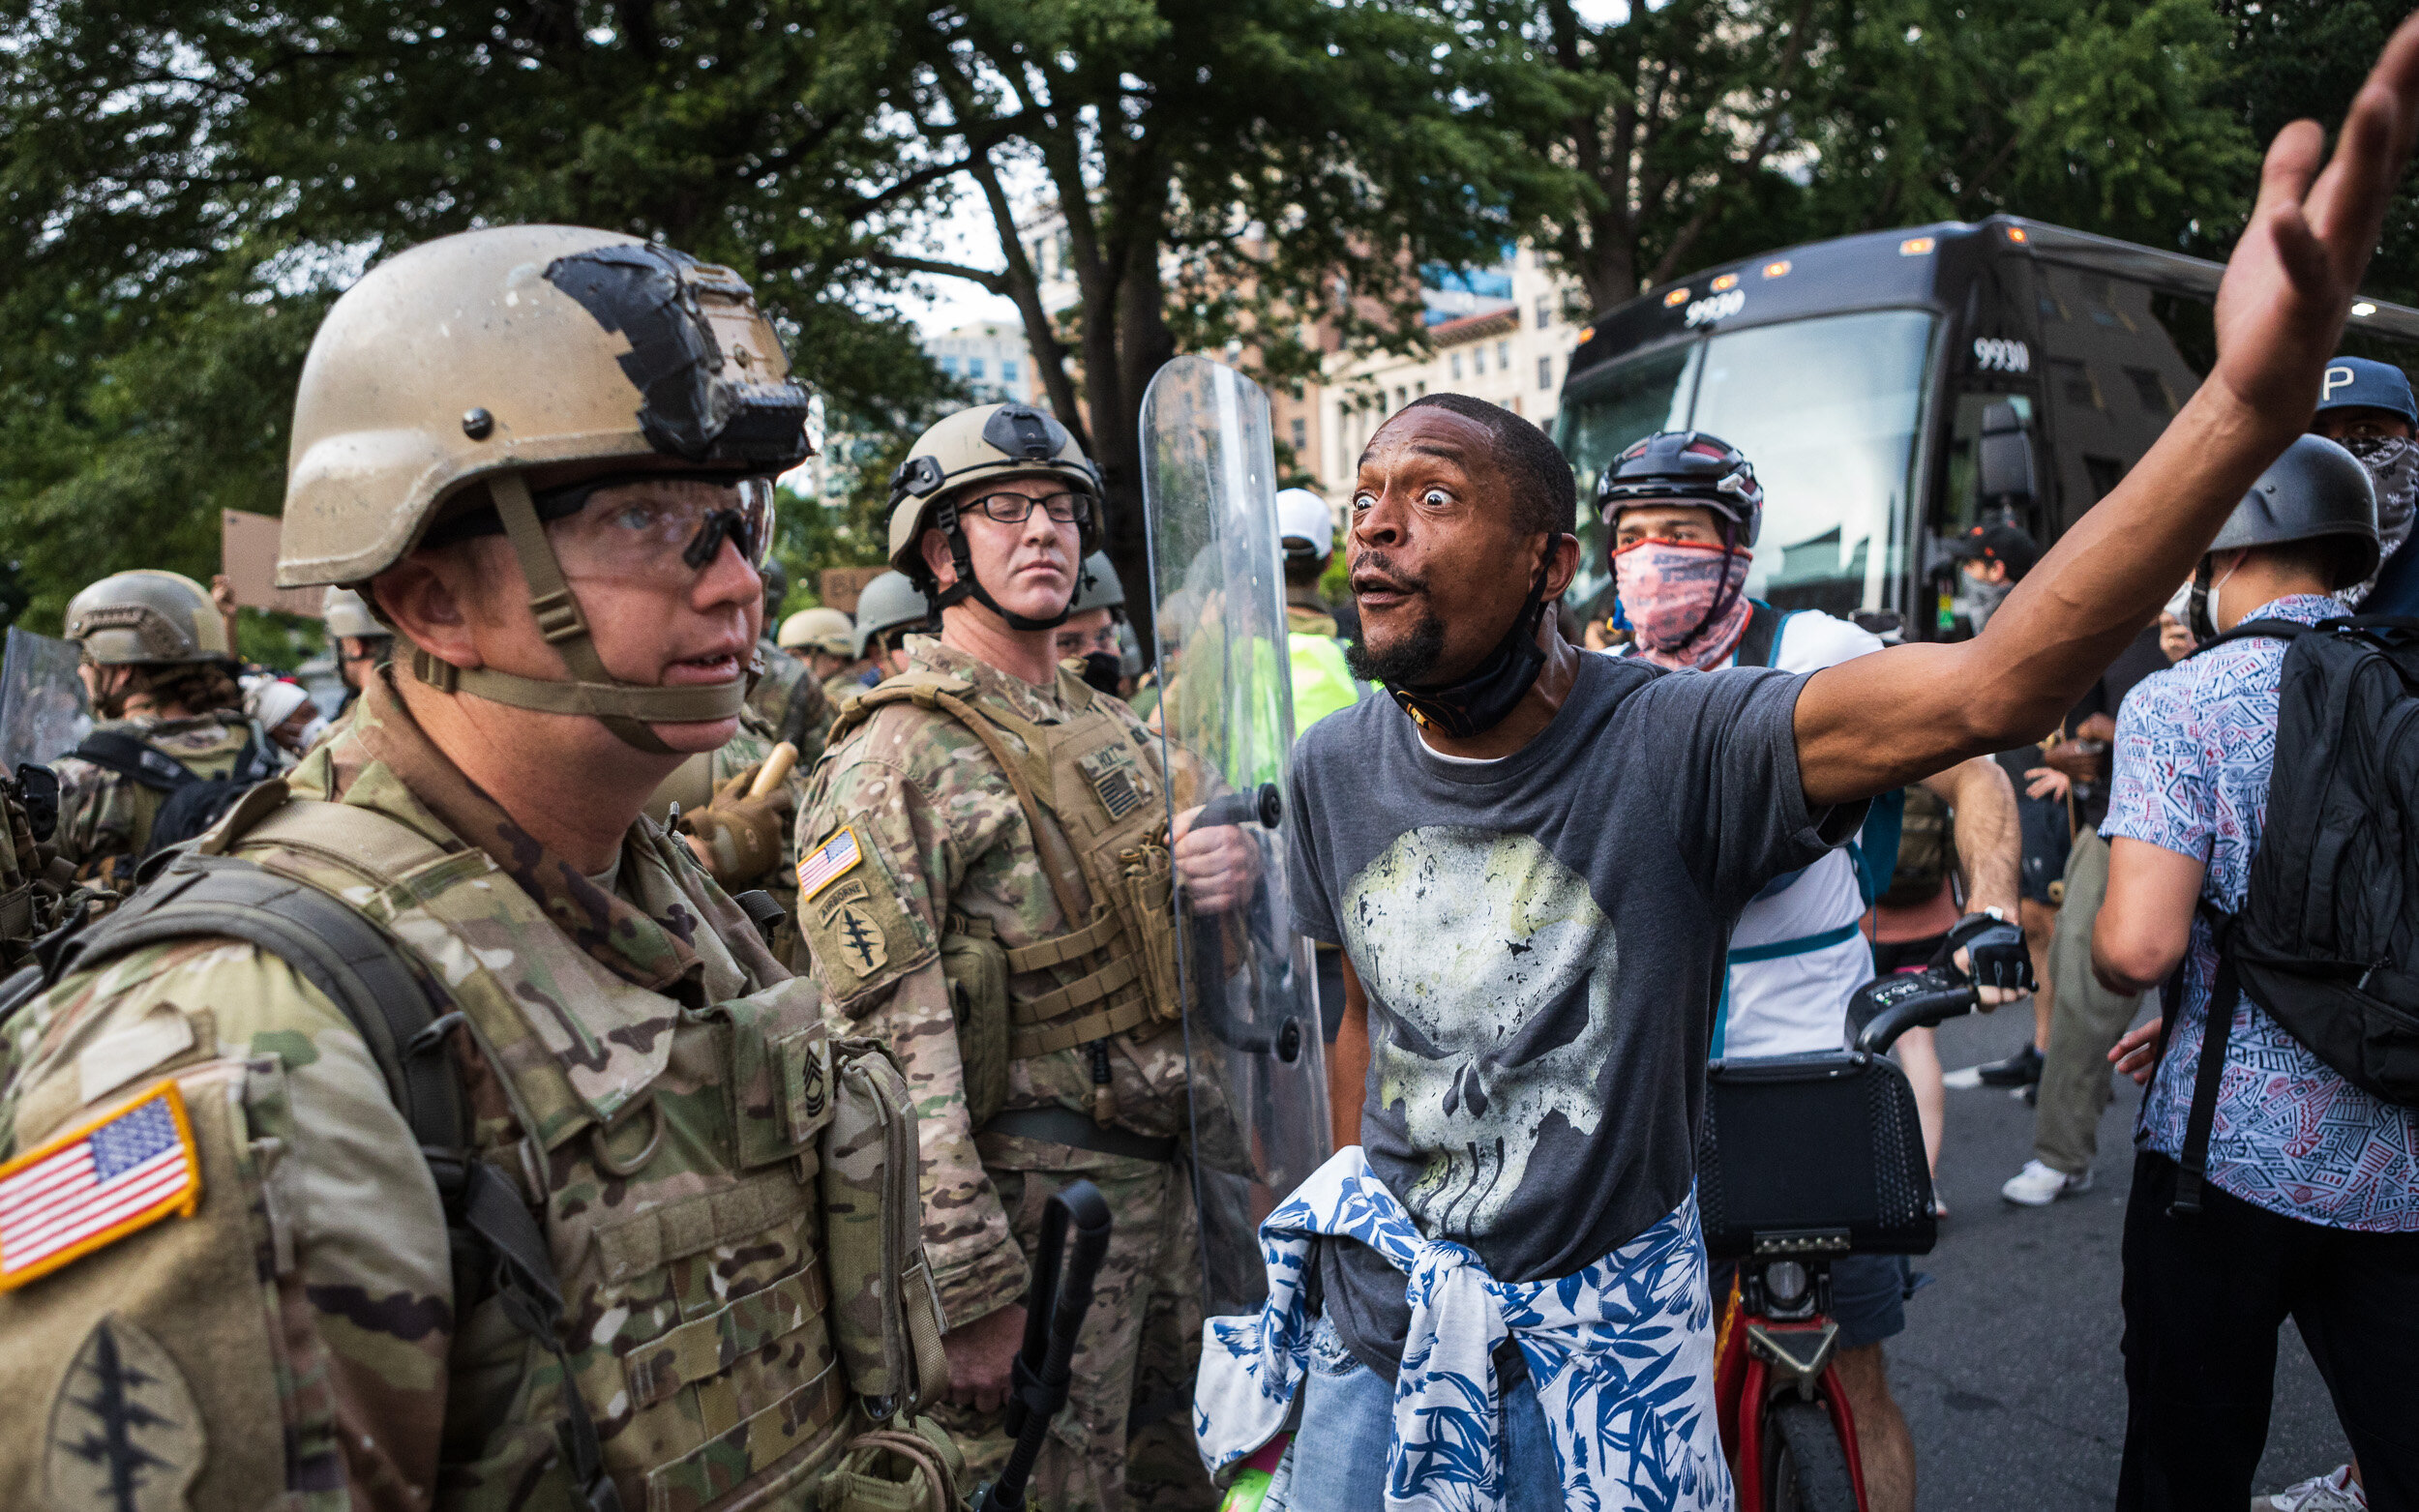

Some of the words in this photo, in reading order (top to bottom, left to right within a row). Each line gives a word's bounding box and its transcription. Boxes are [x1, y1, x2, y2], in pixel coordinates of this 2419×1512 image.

[1974, 337, 2030, 372] 9930
[2323, 367, 2354, 401] P
[821, 883, 861, 919] AIRBORNE
